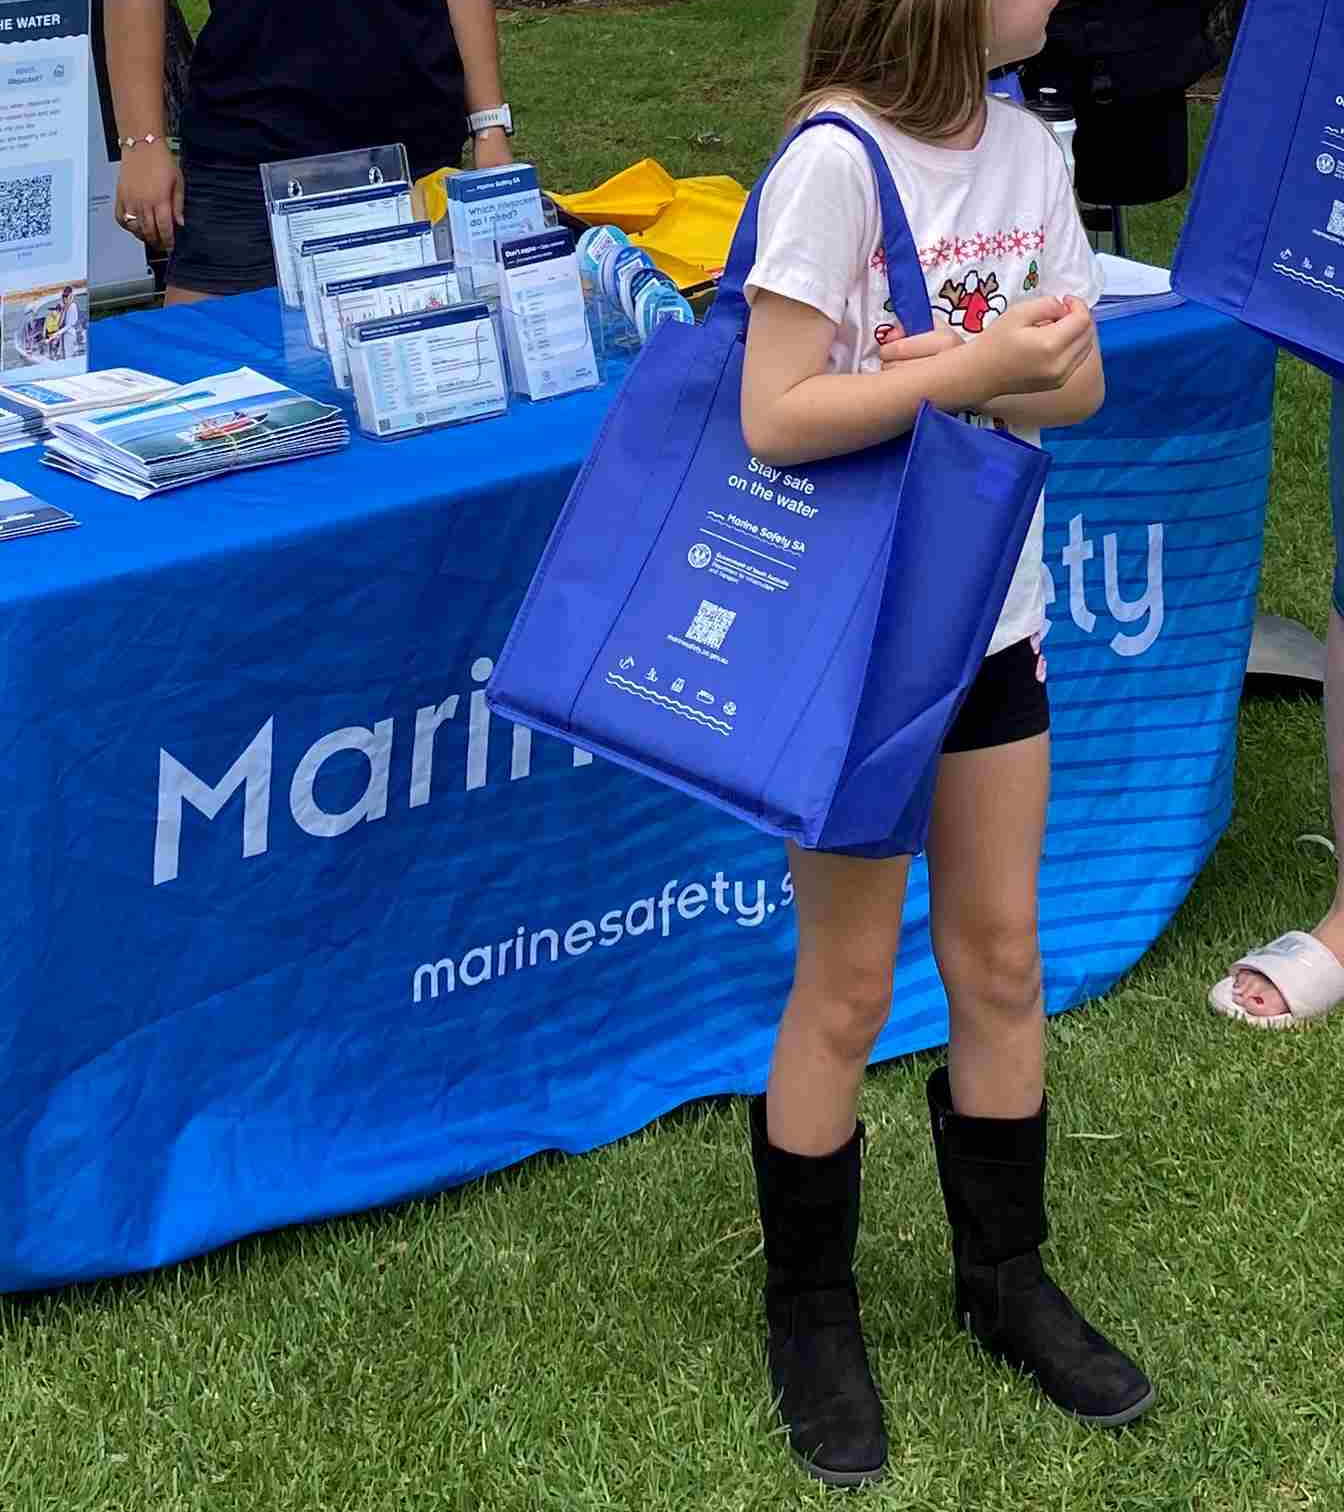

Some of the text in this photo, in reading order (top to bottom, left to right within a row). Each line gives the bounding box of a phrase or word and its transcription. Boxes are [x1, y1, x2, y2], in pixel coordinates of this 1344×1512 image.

[16, 13, 61, 29] WATER
[468, 205, 496, 217] Which
[470, 218, 482, 228] do
[747, 456, 815, 495] Stay safe
[728, 473, 818, 519] on the water
[727, 513, 805, 553] Marine Safety SA
[153, 657, 593, 886] Mari
[413, 870, 794, 1004] marinesafety.s
